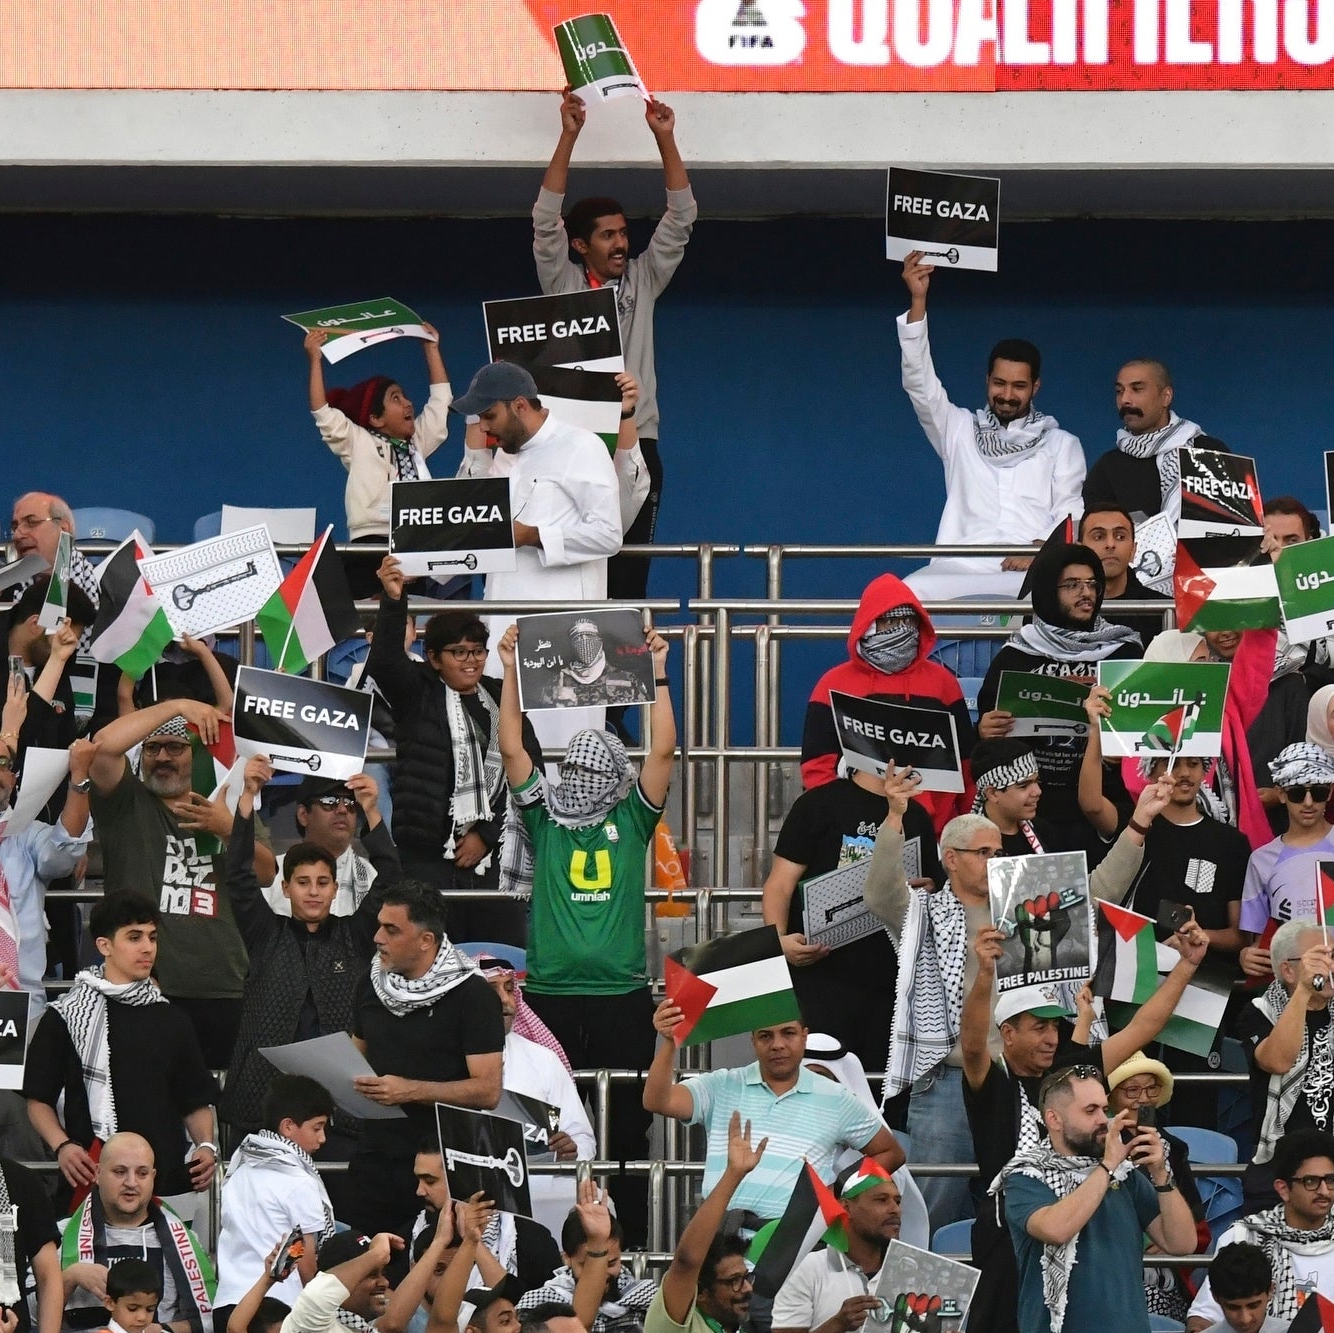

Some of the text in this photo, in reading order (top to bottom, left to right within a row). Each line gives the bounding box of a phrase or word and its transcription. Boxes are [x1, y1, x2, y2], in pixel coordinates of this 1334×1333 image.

[729, 35, 774, 48] FIFA
[894, 194, 990, 222] FREE GAZA
[317, 309, 397, 328] عائدون
[497, 316, 611, 345] FREE GAZA
[1186, 475, 1256, 500] FREE GAZA
[399, 504, 503, 526] FREE GAZA
[981, 615, 995, 624] 29
[243, 695, 360, 731] FREE GAZA
[842, 716, 946, 749] FREE GAZA
[570, 889, 611, 902] umniah
[998, 965, 1089, 990] FREE PALESTINE
[523, 1122, 549, 1146] ZA
[170, 1222, 211, 1313] PALESTINE
